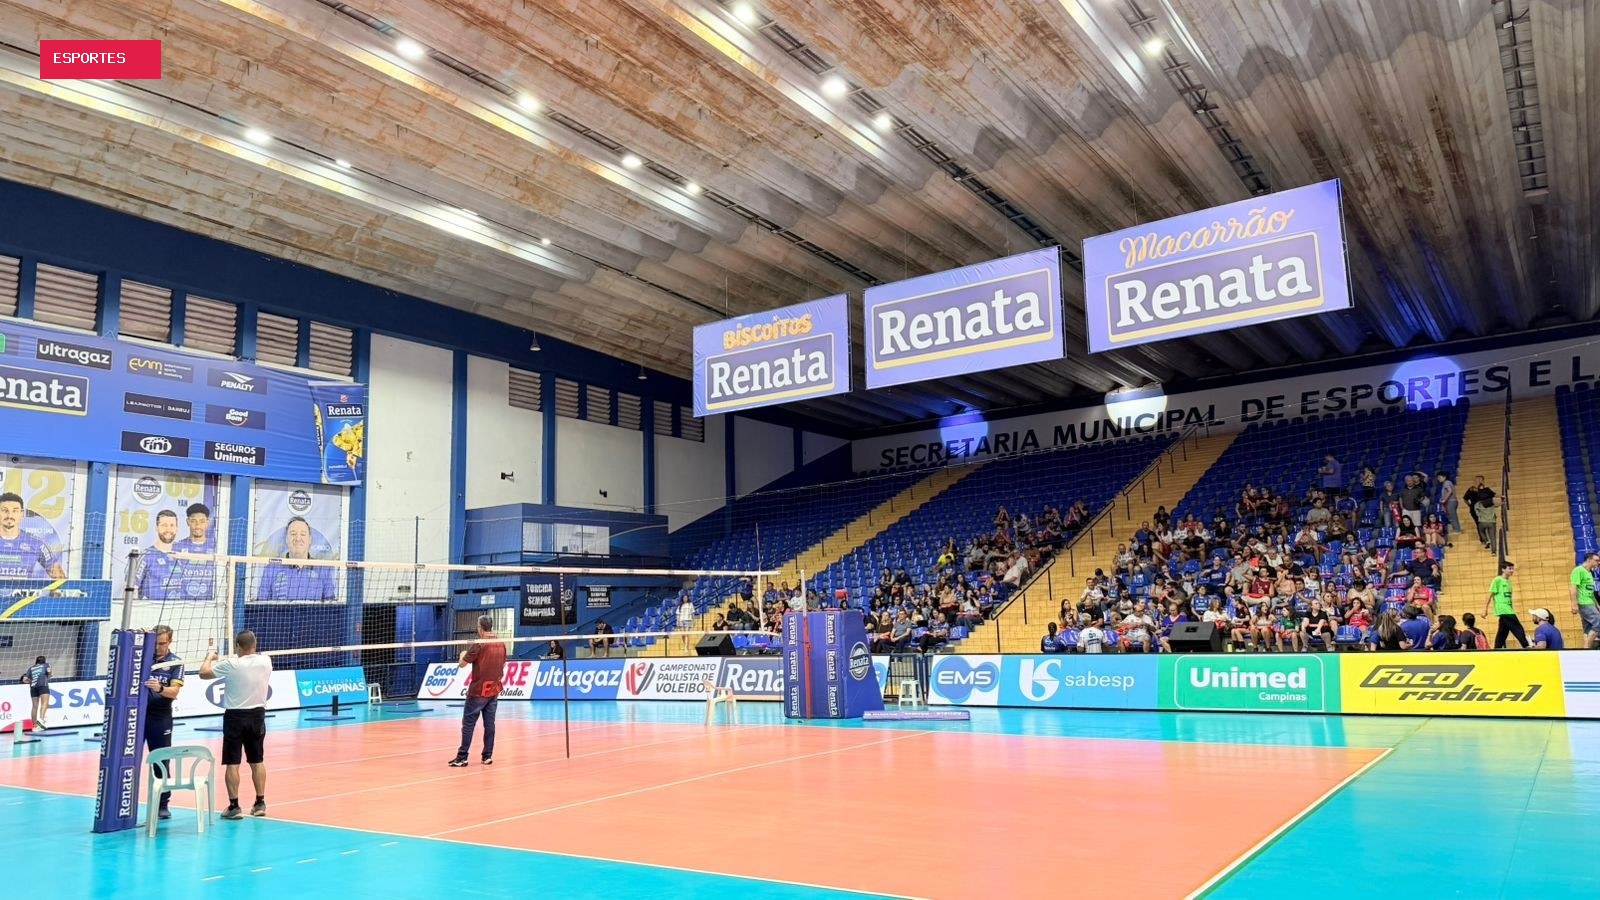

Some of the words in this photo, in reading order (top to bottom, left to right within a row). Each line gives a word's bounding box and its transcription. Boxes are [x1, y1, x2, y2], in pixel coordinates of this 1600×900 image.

[1120, 206, 1296, 269] Macarrão
[1114, 252, 1313, 328] Renata
[878, 288, 1045, 356] Renata
[39, 342, 110, 365] ultragaz
[710, 348, 828, 399] Renata
[221, 380, 254, 392] PENALTY
[225, 413, 243, 422] Bom
[229, 408, 248, 417] Good
[328, 405, 362, 416] Renata
[880, 429, 1041, 468] SECRETARIA
[1053, 405, 1225, 447] MUNICIPAL
[1241, 395, 1285, 423] DE
[1301, 366, 1509, 415] ESPORTES
[1529, 360, 1551, 387] E
[214, 442, 257, 455] SEGUROS
[214, 451, 256, 465] Unimed
[135, 484, 161, 494] Renata
[119, 509, 149, 534] 16
[526, 583, 553, 593] TORCIDA
[528, 596, 552, 605] SEMPRE
[523, 607, 556, 617] CAMPINAS
[788, 614, 797, 646] Renata
[827, 613, 835, 644] Renata
[130, 649, 143, 696] Renata
[434, 664, 458, 676] Good
[659, 663, 717, 672] CAMPEONATO
[789, 650, 797, 681] Renata
[828, 650, 836, 680] Renata
[425, 675, 447, 686] Bom
[536, 665, 622, 693] ultragaz
[657, 672, 700, 681] PAULISTA
[701, 672, 715, 681] DE
[725, 663, 784, 692] Rena
[938, 670, 992, 685] EMS
[1064, 671, 1135, 691] sabesp
[1190, 666, 1307, 689] Unimed
[1367, 668, 1460, 685] Foco
[314, 682, 365, 694] CAMPINAS
[1258, 691, 1307, 703] Campinas
[830, 686, 838, 717] Renata
[124, 708, 138, 757] Renata
[119, 768, 133, 819] Renata
